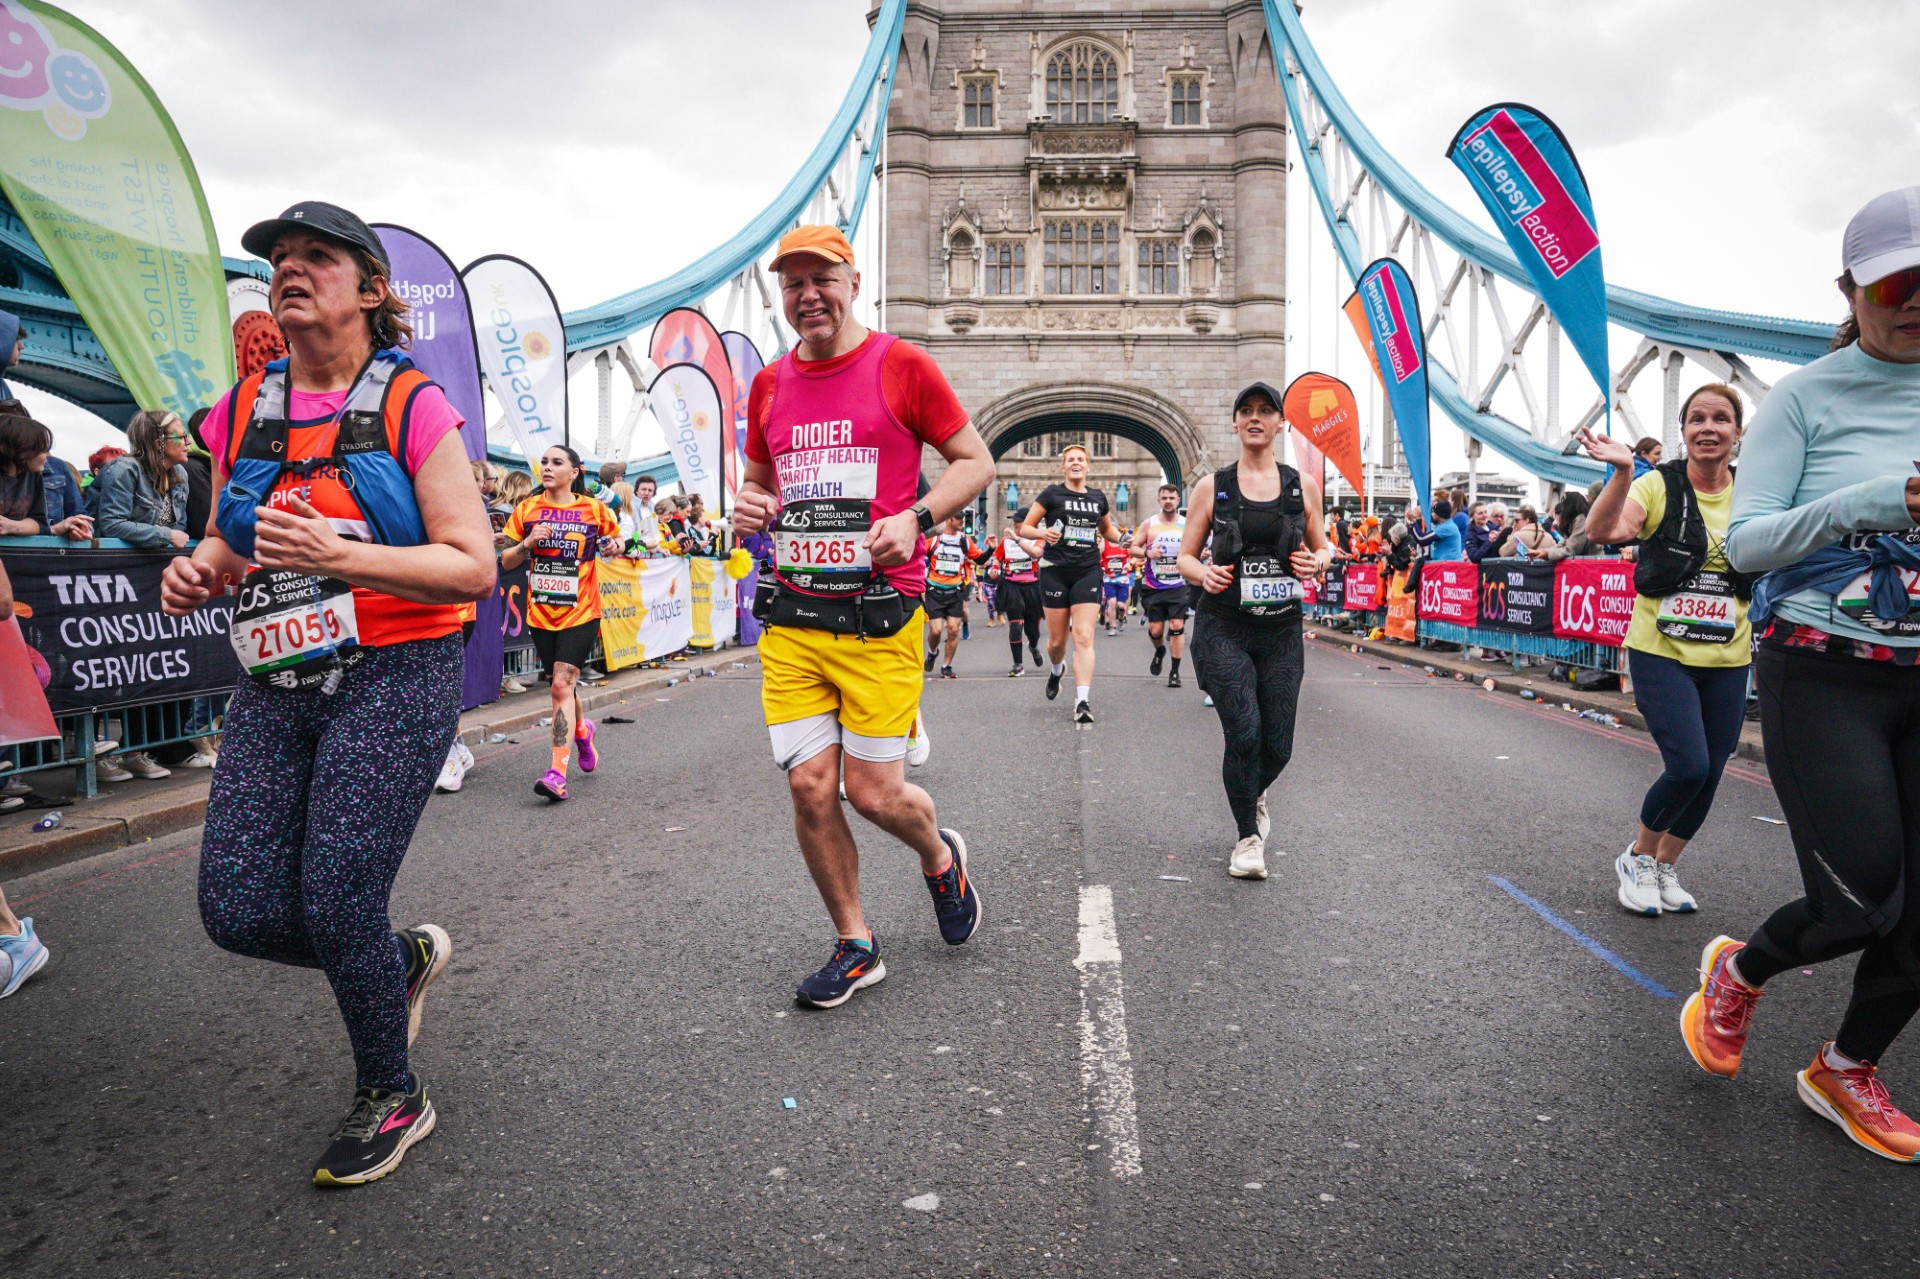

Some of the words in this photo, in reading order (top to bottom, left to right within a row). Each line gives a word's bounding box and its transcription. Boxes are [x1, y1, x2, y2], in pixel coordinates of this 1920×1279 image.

[1471, 138, 1532, 216] epilepsy
[1524, 214, 1570, 270] action
[1367, 281, 1392, 337] epilepsy
[1387, 338, 1406, 378] action
[792, 419, 853, 450] DIDIER
[340, 441, 374, 451] EVADICT
[775, 454, 793, 473] THE
[795, 450, 825, 468] DEAF
[827, 449, 878, 464] HEALTH
[266, 485, 312, 508] PICE
[540, 509, 582, 521] PAIGE
[1065, 500, 1100, 514] ELLIE
[782, 510, 811, 528] tcs
[814, 511, 865, 520] CONSULTANCY
[538, 539, 578, 550] CANCER
[789, 540, 856, 564] 31265
[563, 550, 576, 558] UK
[1243, 561, 1268, 575] tcs
[270, 571, 303, 582] TATA
[1443, 571, 1456, 584] TATA
[1507, 572, 1524, 587] TATA
[1601, 574, 1627, 591] TATA
[48, 574, 138, 605] TATA
[537, 578, 570, 592] 35206
[829, 582, 864, 591] balance
[1252, 582, 1295, 600] 65497
[1699, 584, 1724, 592] SERVICES
[275, 586, 322, 603] SERVICES
[1421, 576, 1441, 613] tcs
[1442, 587, 1473, 602] CONSULTANCY
[1482, 572, 1506, 620] tcs
[1507, 590, 1547, 608] CONSULTANCY
[1441, 604, 1462, 617] SERVICES
[1560, 573, 1596, 633] tcs
[1672, 597, 1727, 620] 33844
[1507, 610, 1532, 625] SERVICES
[250, 608, 340, 659] 27059
[1686, 632, 1701, 640] new
[1701, 633, 1727, 641] balance
[72, 649, 190, 692] SERVICES
[301, 672, 322, 686] new
